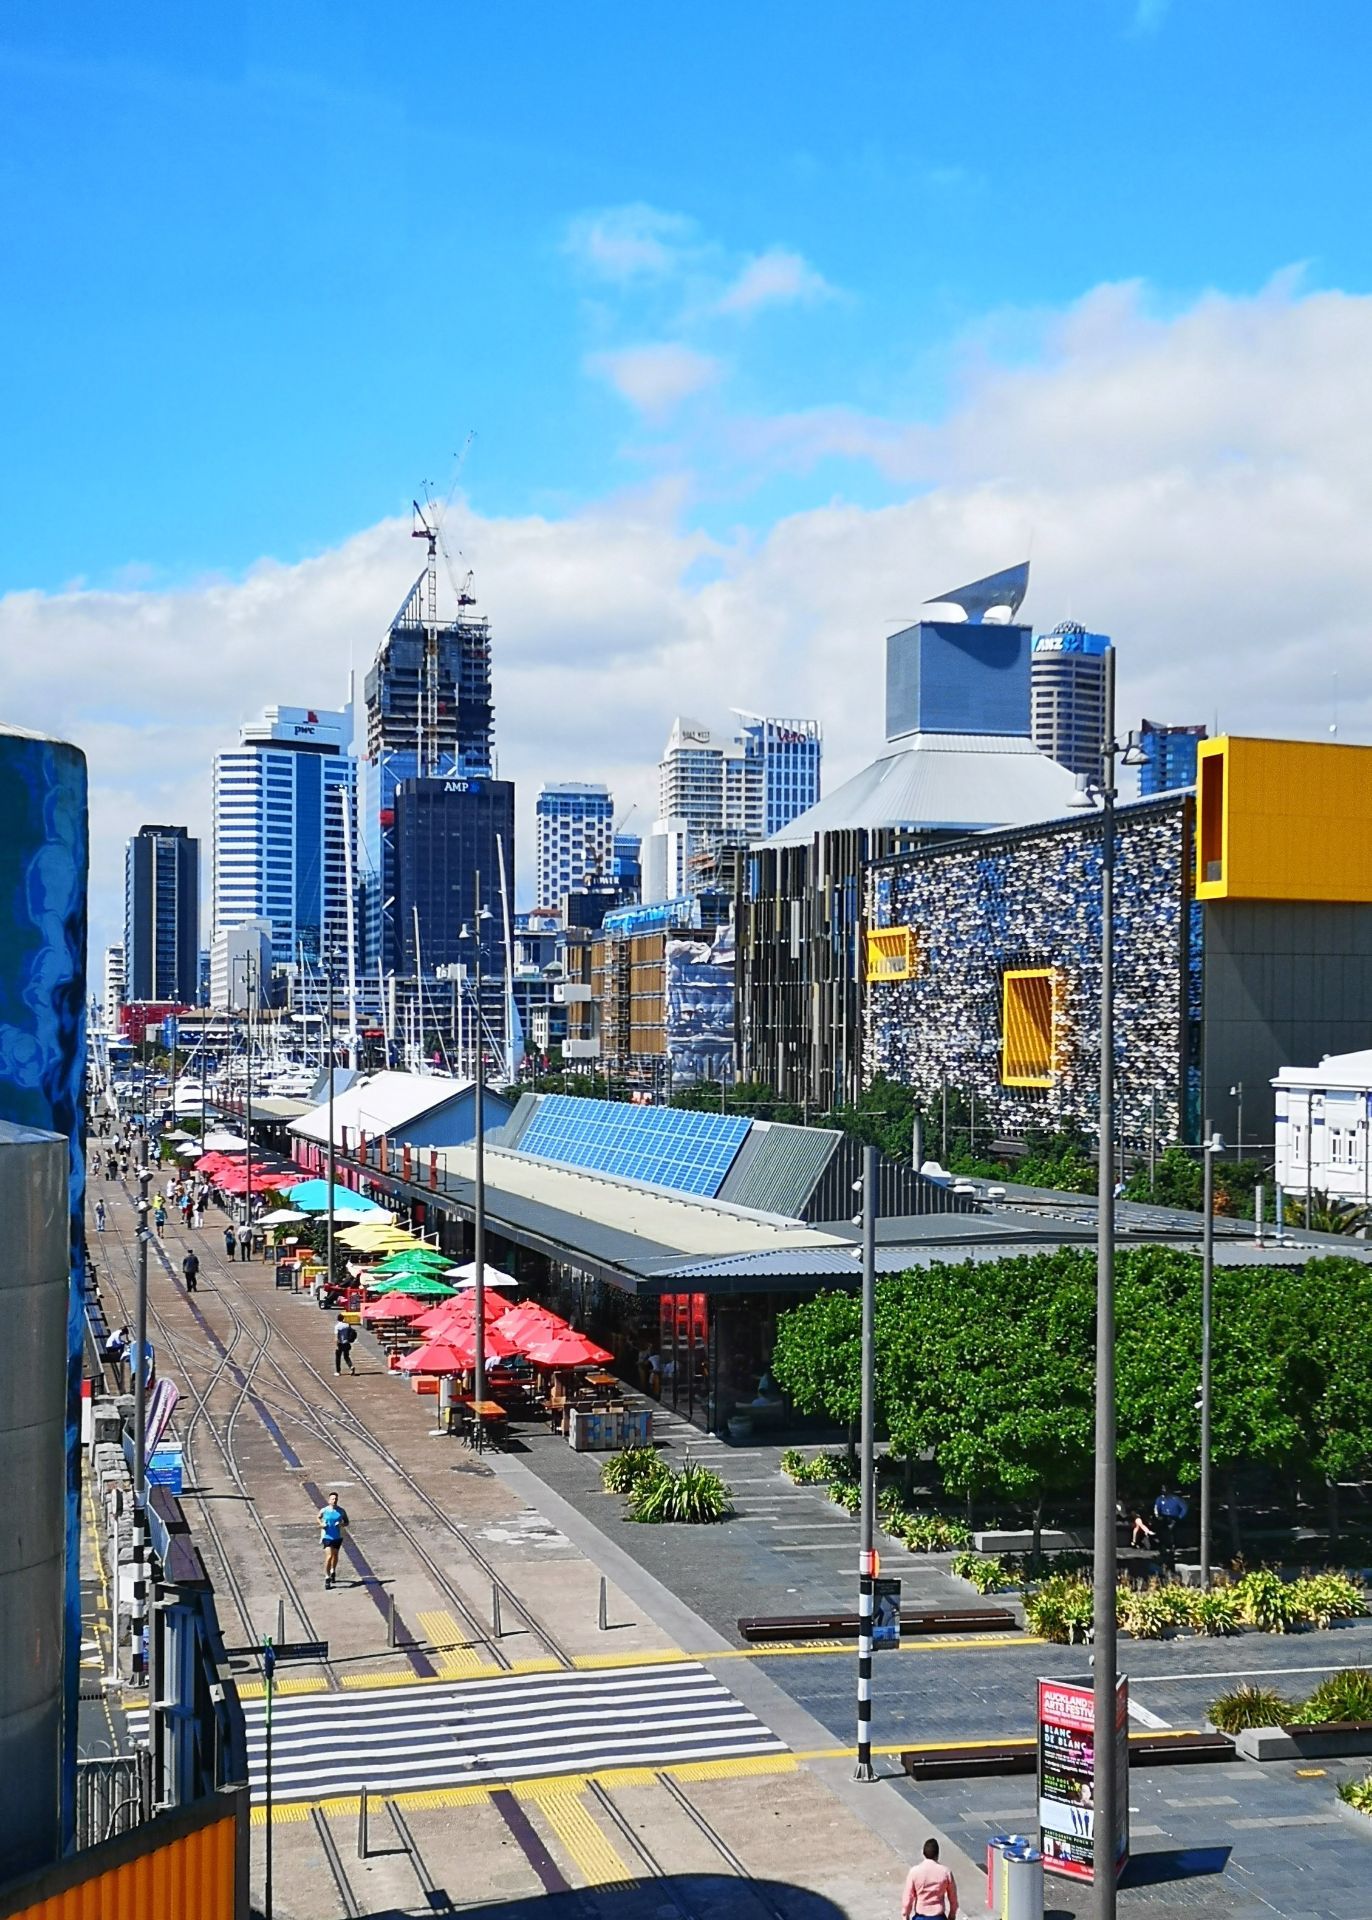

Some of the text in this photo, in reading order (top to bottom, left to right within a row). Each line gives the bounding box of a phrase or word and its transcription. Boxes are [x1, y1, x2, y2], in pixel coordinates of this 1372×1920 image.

[1036, 637, 1064, 652] ANZ
[294, 725, 315, 735] pwc
[444, 781, 469, 792] AMP
[1044, 1699, 1066, 1713] ARTS
[1045, 1691, 1088, 1707] AUCKLAND
[1044, 1724, 1072, 1739] BLANC
[1044, 1733, 1055, 1744] DE
[1058, 1736, 1087, 1751] BLANC
